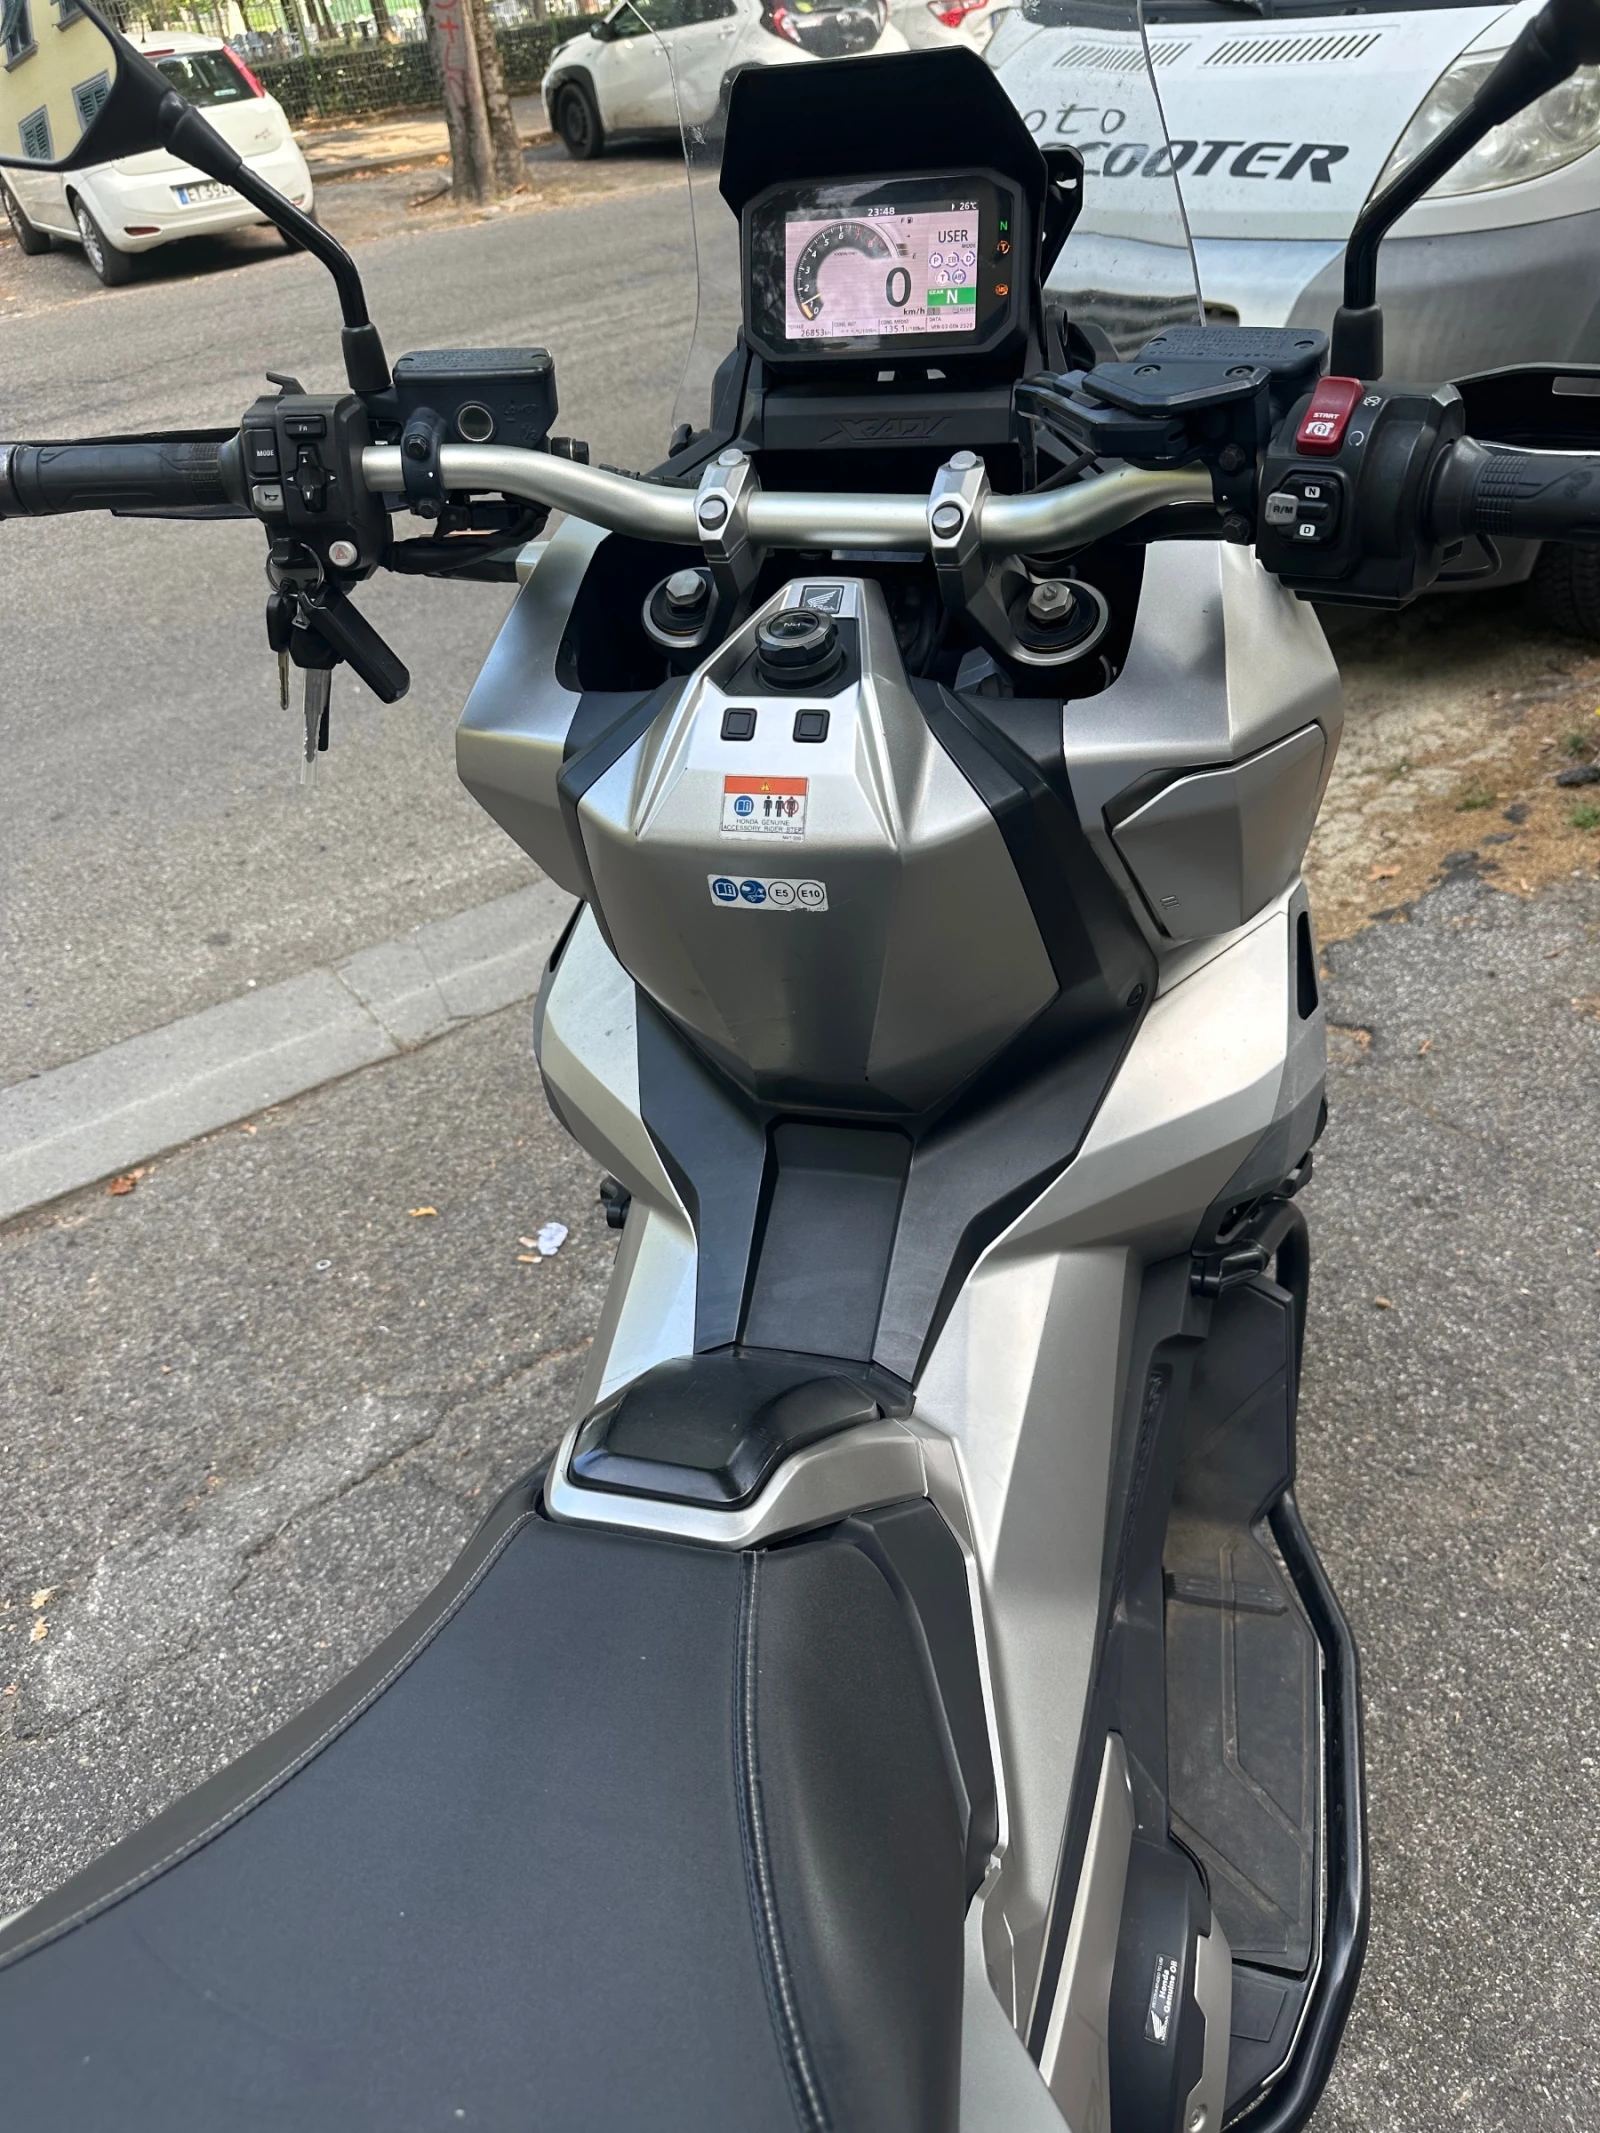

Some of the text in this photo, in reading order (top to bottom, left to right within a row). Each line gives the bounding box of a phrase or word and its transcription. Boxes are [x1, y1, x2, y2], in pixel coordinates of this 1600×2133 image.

[867, 206, 895, 217] 23:48
[1000, 220, 1008, 231] N
[838, 232, 844, 240] 6
[938, 229, 968, 244] USER
[824, 238, 830, 246] 5
[811, 250, 817, 258] 4
[804, 266, 811, 274] 3
[803, 284, 810, 292] 2
[885, 266, 912, 308] 0
[946, 289, 958, 304] N
[813, 306, 819, 314] 0
[903, 307, 926, 316] km/h
[800, 329, 825, 338] 26853
[1312, 412, 1340, 420] START
[298, 424, 308, 432] Fn
[256, 449, 275, 457] MODE
[1308, 487, 1317, 496] N
[1272, 504, 1294, 515] R/M
[1303, 526, 1311, 535] D
[723, 824, 761, 832] ACCESSORY
[786, 826, 803, 834] STEP
[775, 889, 789, 898] E5
[801, 889, 820, 898] E10
[1159, 1969, 1170, 1999] Honda
[1163, 1960, 1178, 2013] Genuine Oil
